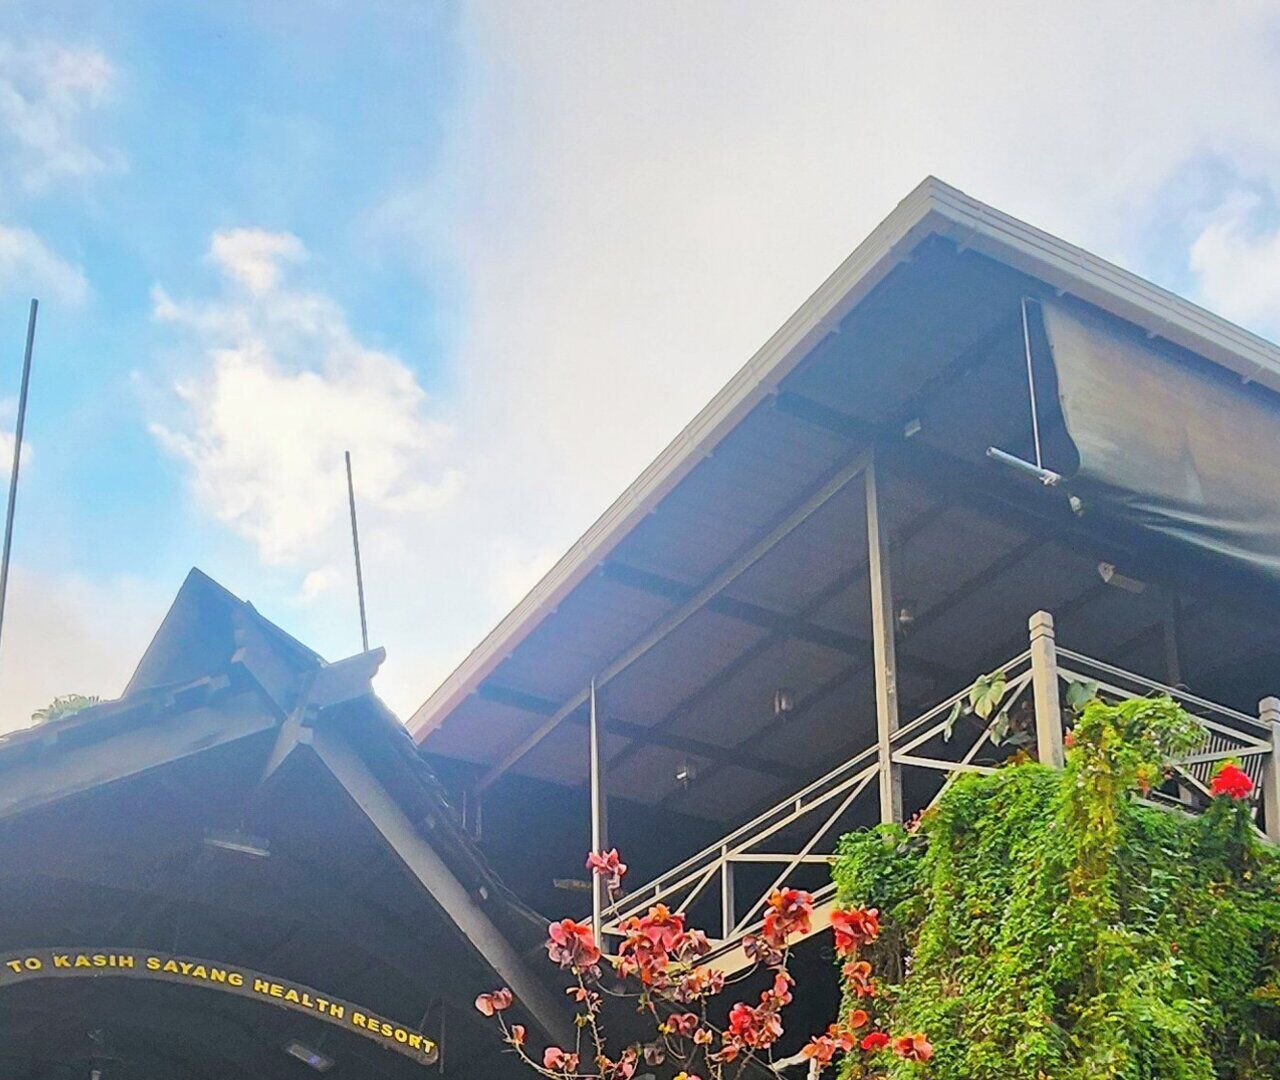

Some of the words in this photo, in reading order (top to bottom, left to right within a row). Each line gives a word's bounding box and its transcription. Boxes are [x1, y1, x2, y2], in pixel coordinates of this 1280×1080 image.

[8, 957, 42, 972] TO
[53, 954, 135, 969] KASIH
[146, 957, 243, 987] SAYANG
[253, 979, 344, 1019] HEALTH
[352, 1012, 437, 1054] RESORT
